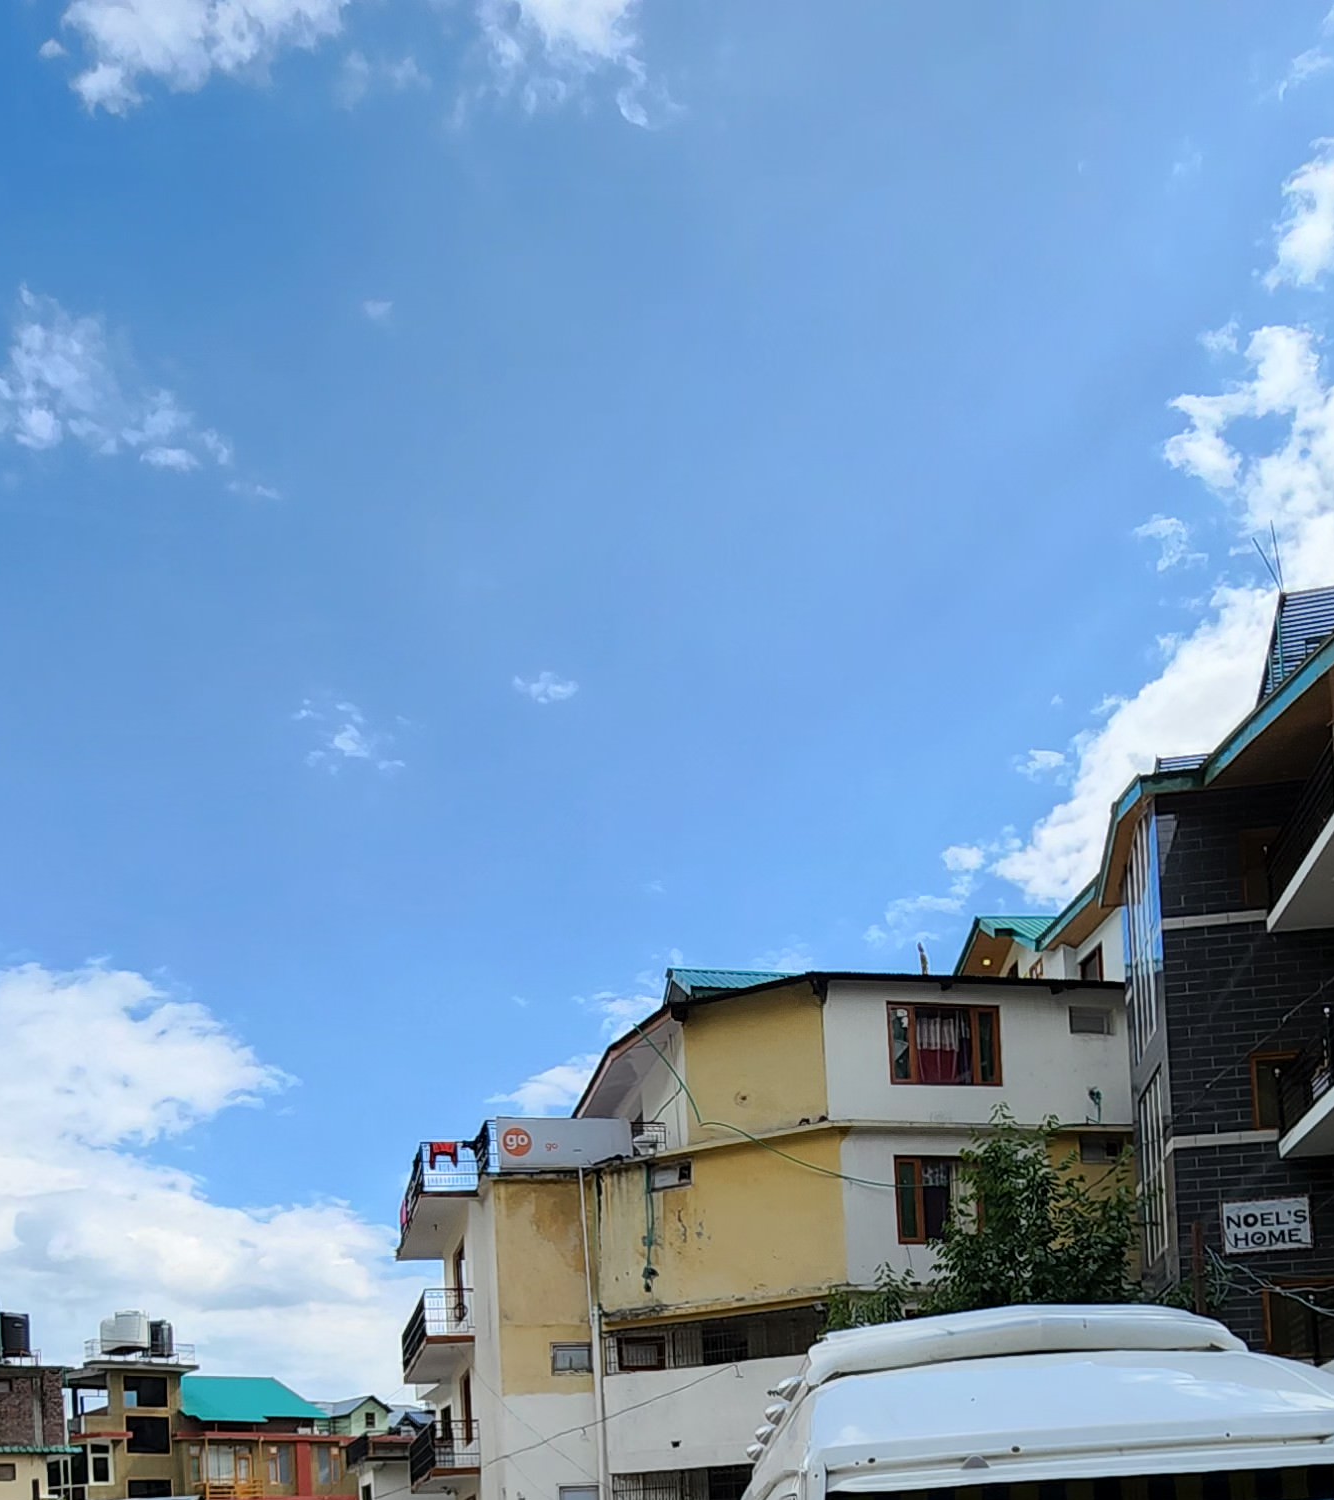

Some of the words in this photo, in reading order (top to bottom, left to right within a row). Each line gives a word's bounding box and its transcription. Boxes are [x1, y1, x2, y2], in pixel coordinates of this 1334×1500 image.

[506, 1134, 529, 1150] go
[1226, 1209, 1308, 1229] NOEL'S
[1234, 1228, 1302, 1247] HOME
